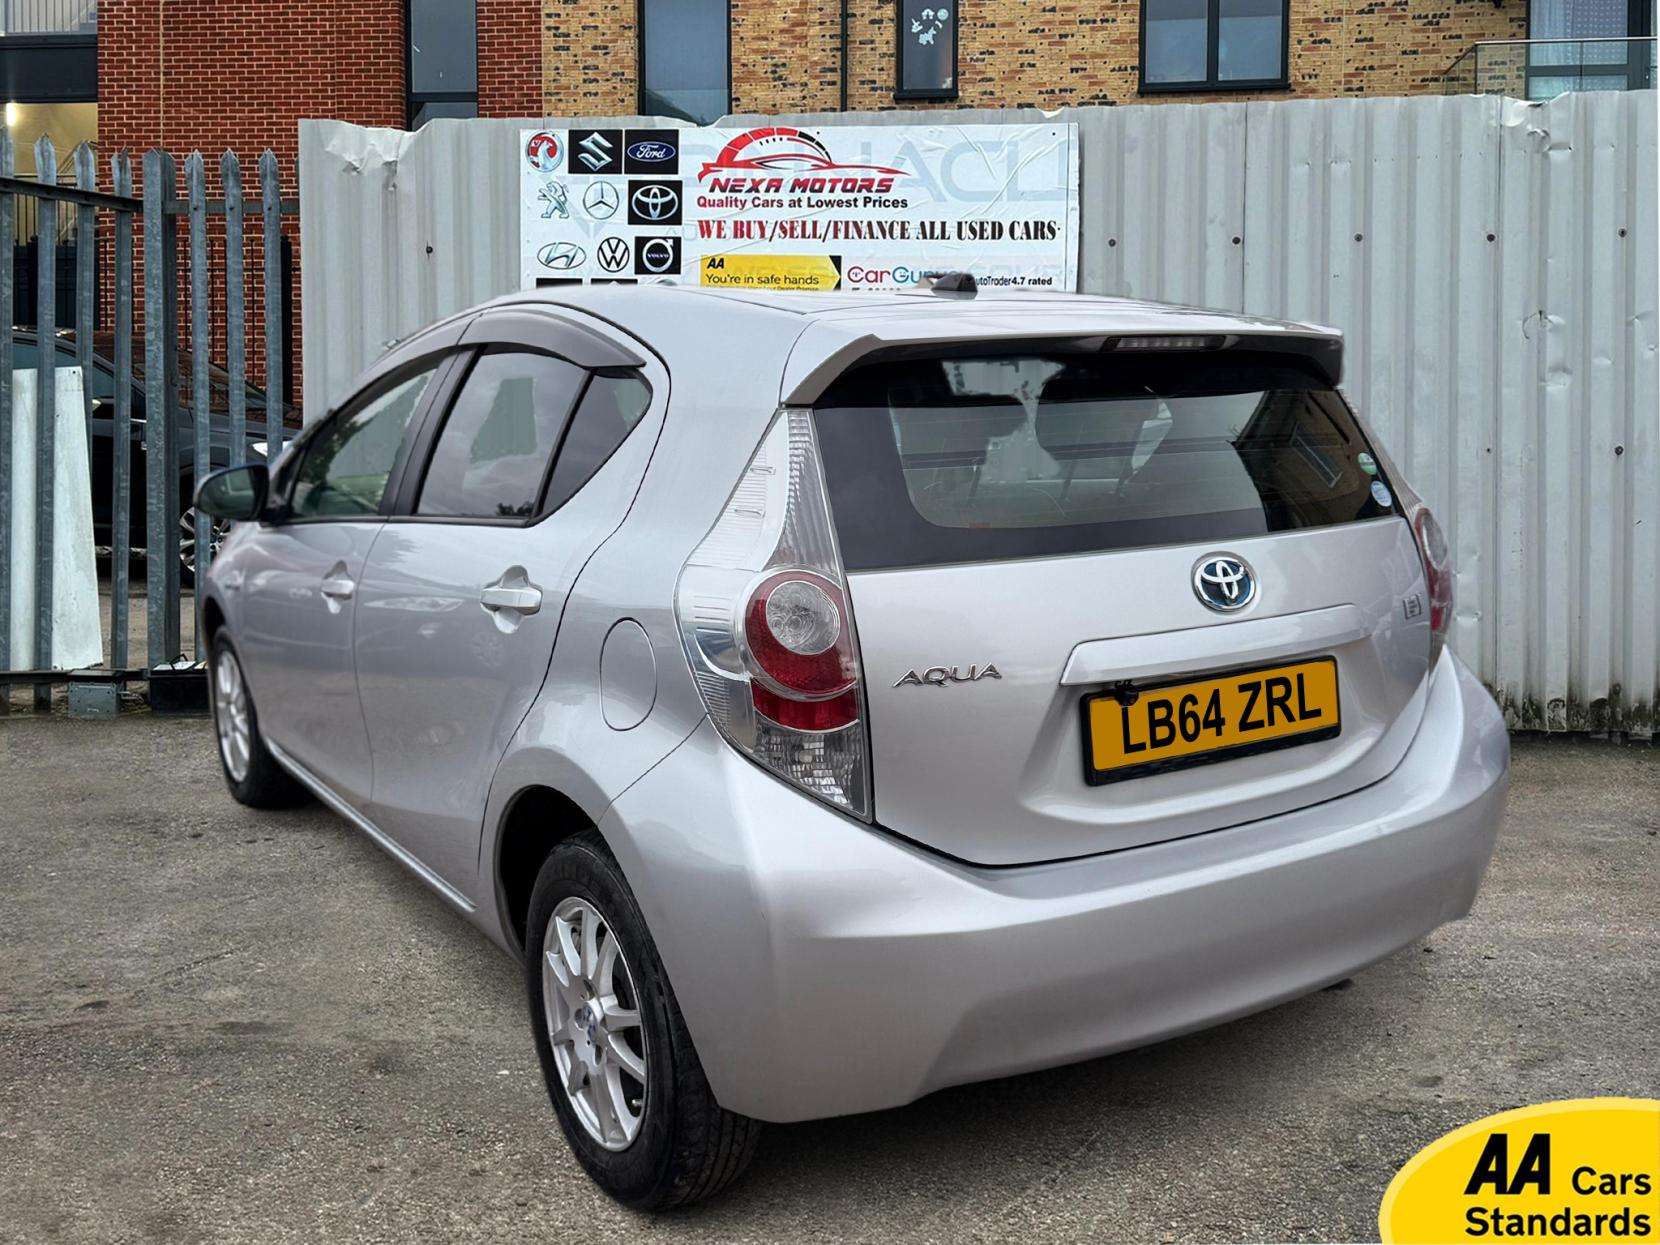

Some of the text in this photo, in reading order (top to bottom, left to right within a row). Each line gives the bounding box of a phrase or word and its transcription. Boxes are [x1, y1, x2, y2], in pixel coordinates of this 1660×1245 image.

[636, 144, 665, 158] Ford
[709, 178, 894, 193] NEXA MOTORS
[697, 196, 908, 210] Quality Cars at Lowest Prices
[698, 220, 727, 240] WE
[916, 220, 950, 240] ALL
[957, 220, 1004, 240] USED
[706, 258, 725, 269] AA
[706, 273, 819, 285] You're in safe hands
[1028, 277, 1052, 285] rated
[893, 662, 1002, 688] AQUA
[1121, 673, 1322, 755] LB64 ZRL
